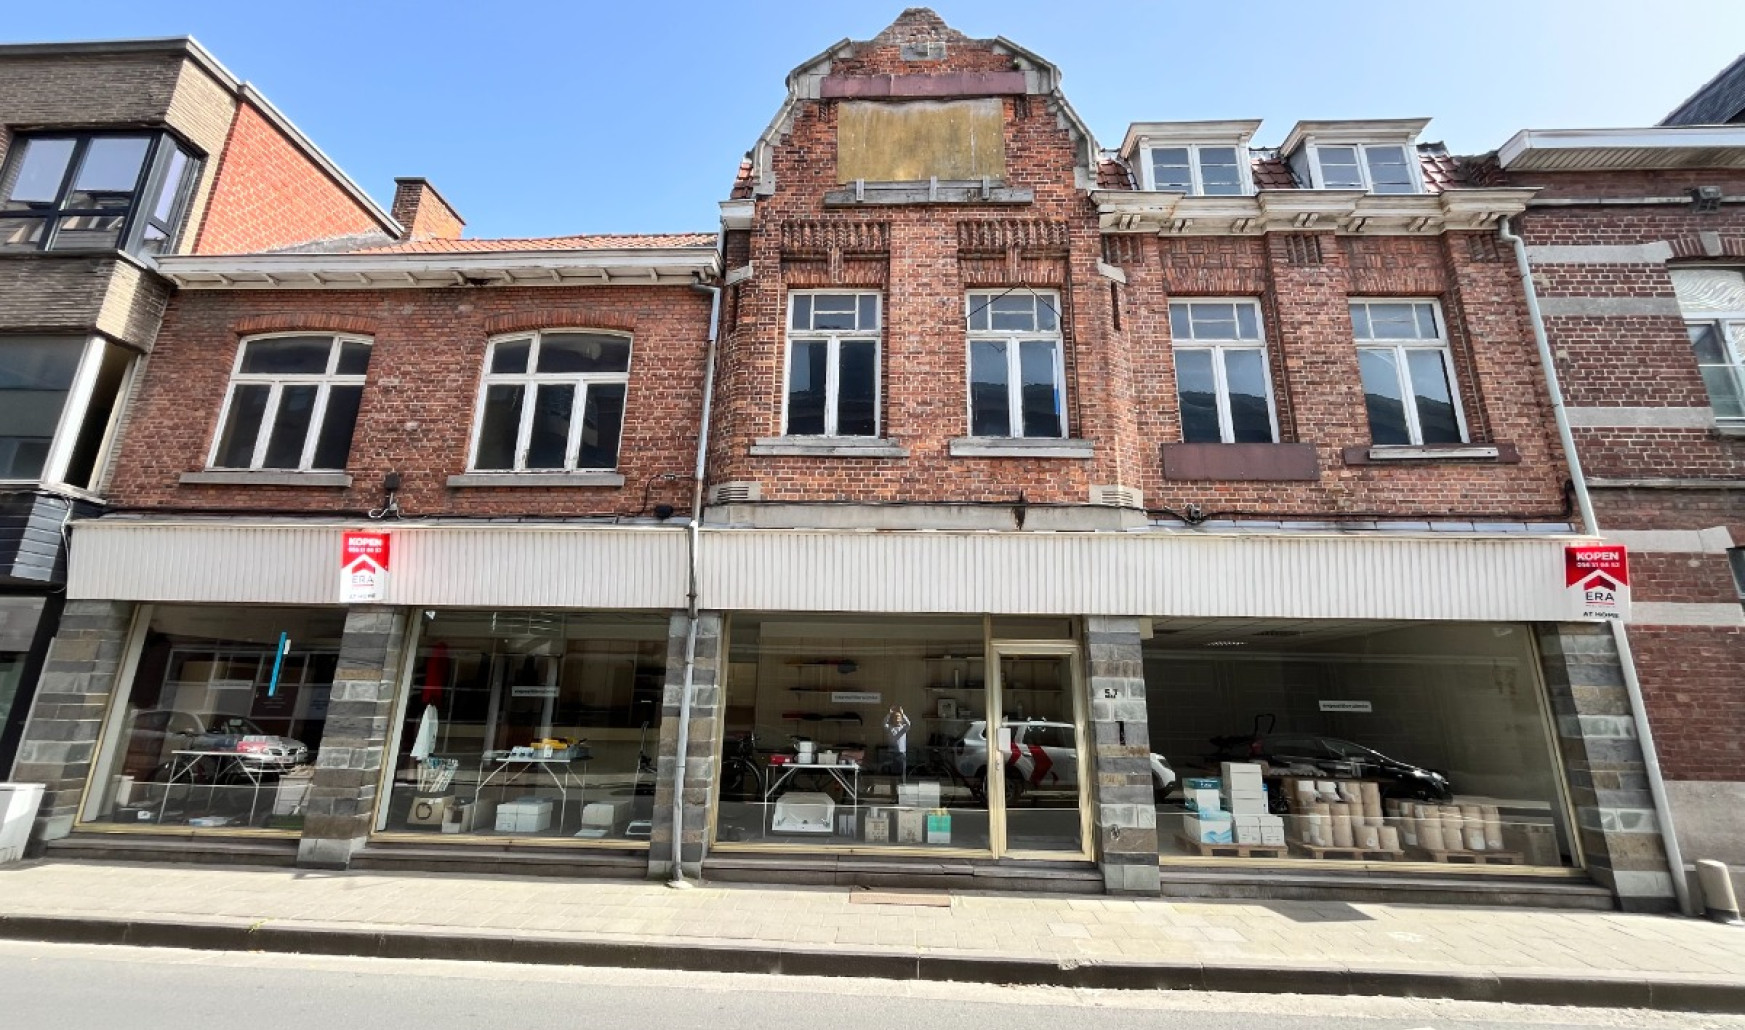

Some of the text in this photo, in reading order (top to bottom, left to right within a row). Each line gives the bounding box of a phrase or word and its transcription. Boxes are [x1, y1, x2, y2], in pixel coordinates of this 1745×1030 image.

[348, 537, 382, 546] KOPEN
[1576, 551, 1620, 561] KOPEN
[352, 575, 375, 584] ERA
[1585, 591, 1615, 601] ERA
